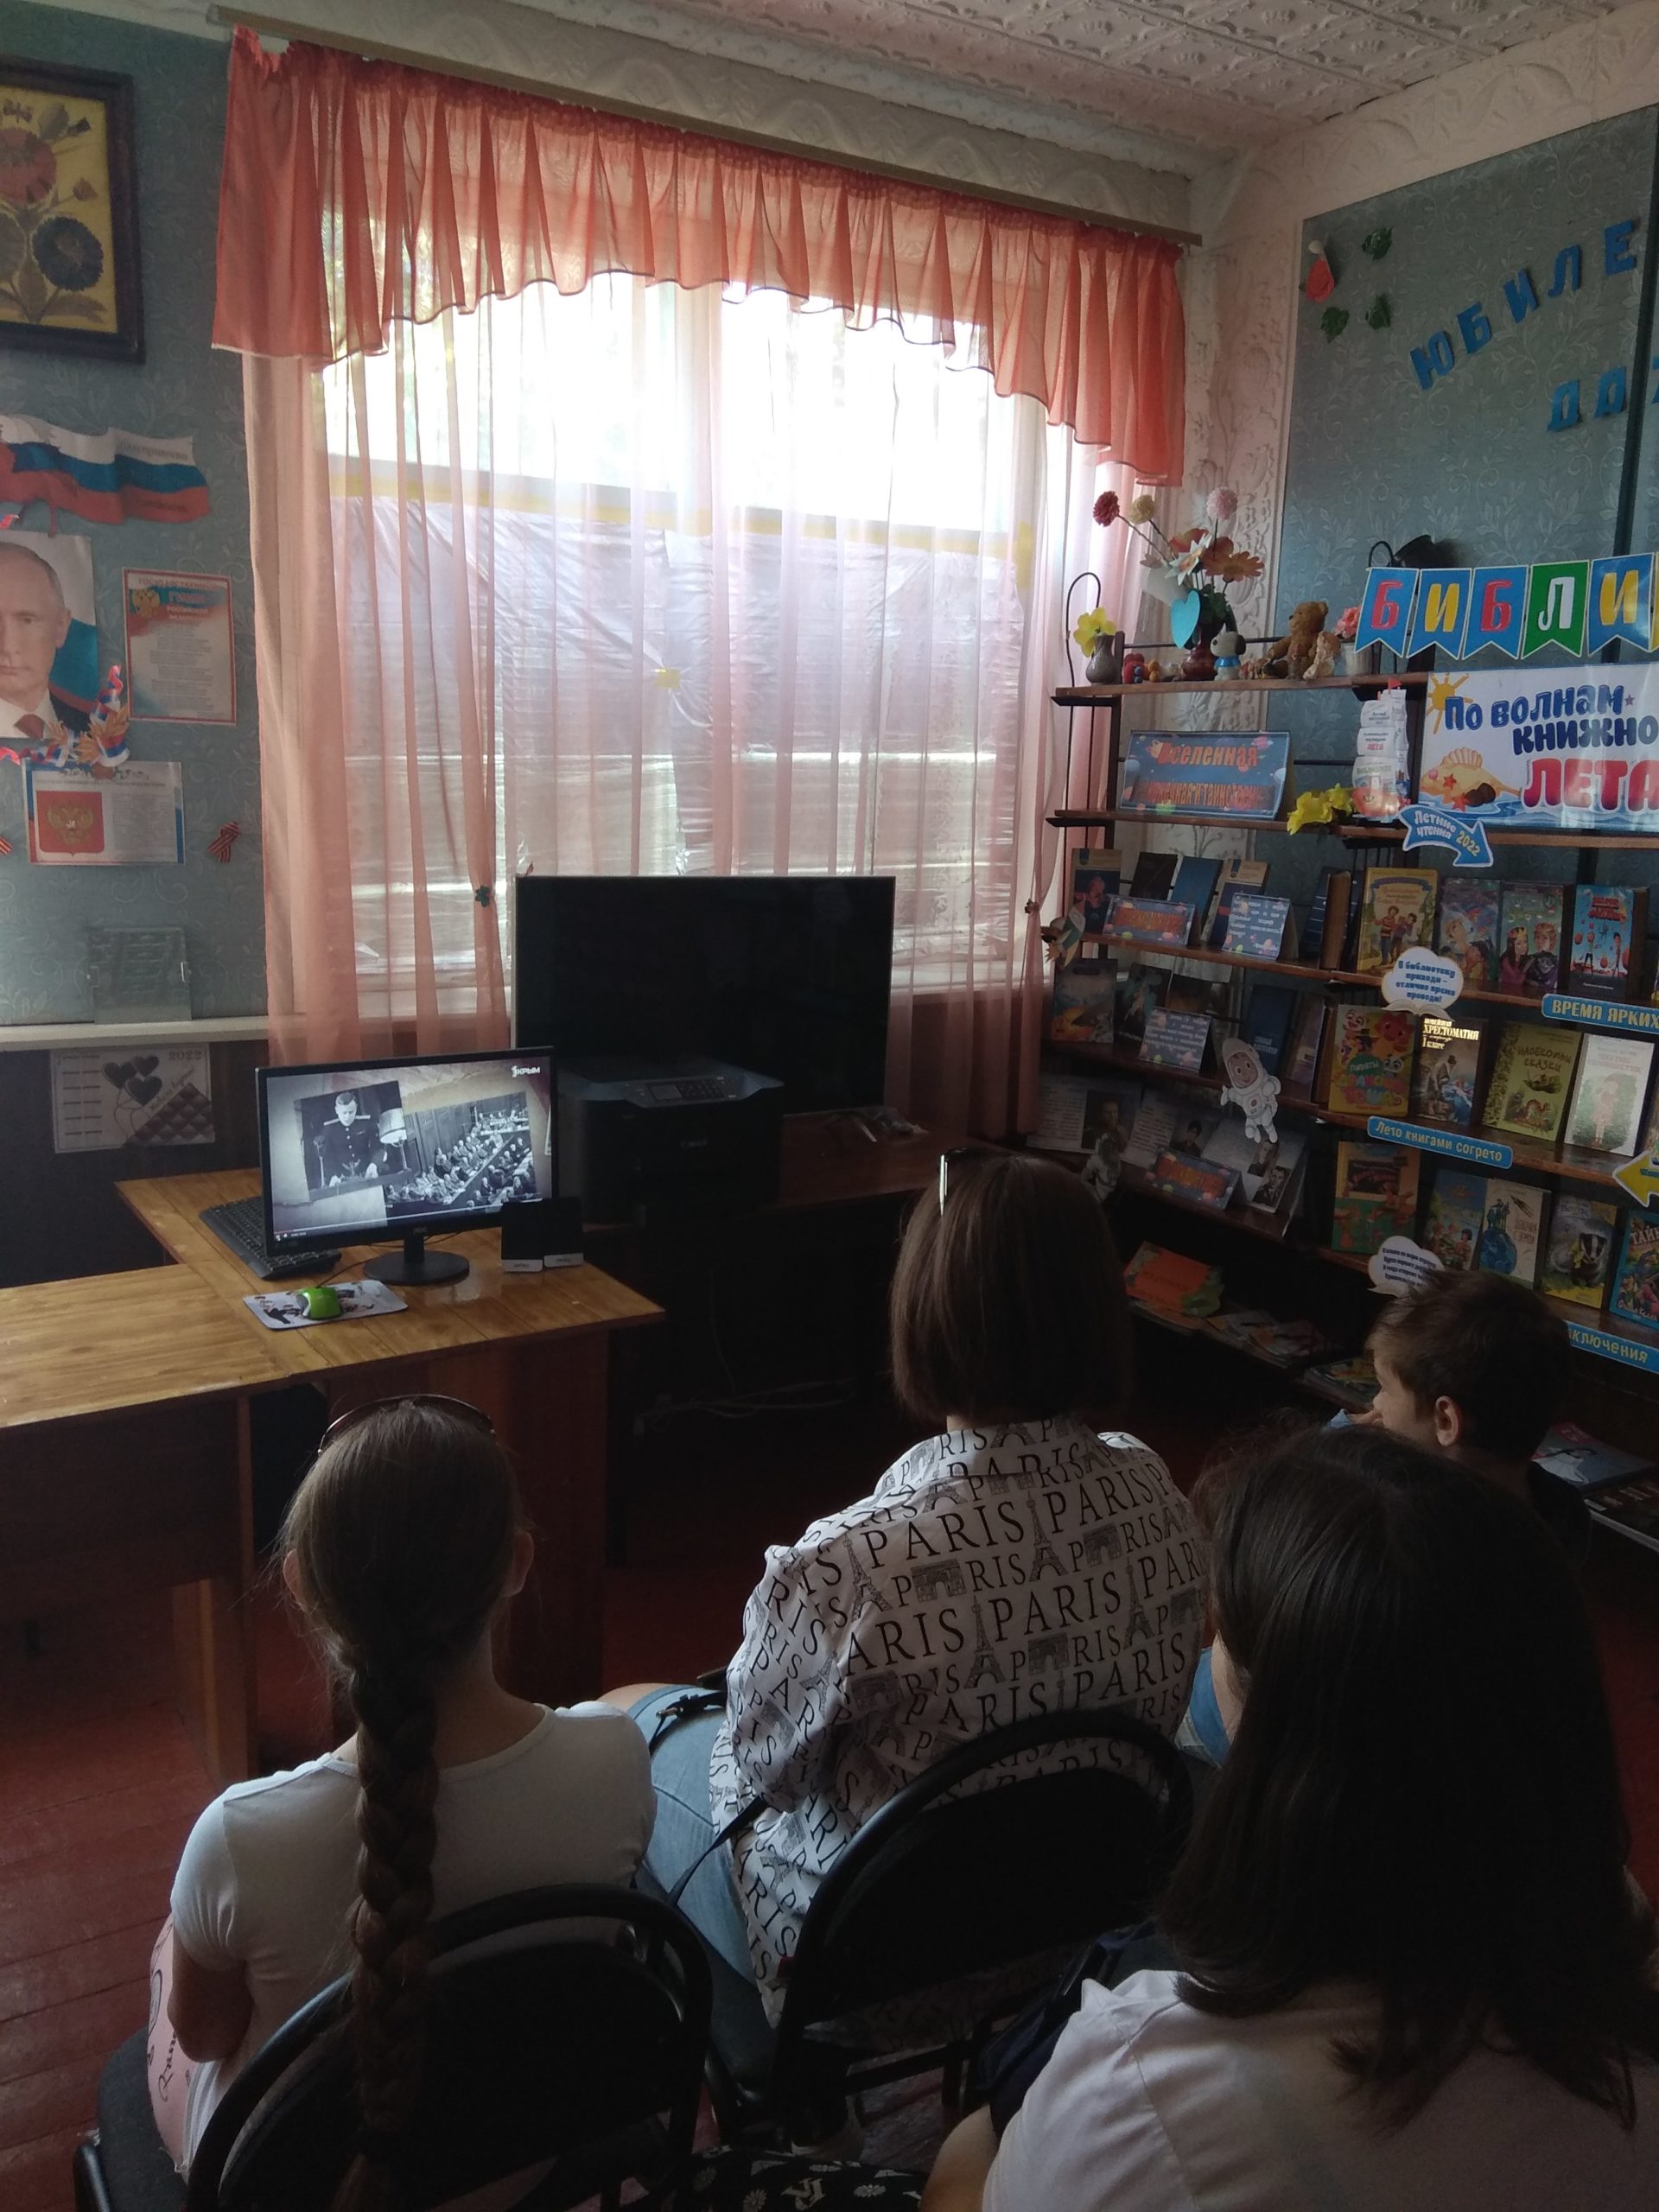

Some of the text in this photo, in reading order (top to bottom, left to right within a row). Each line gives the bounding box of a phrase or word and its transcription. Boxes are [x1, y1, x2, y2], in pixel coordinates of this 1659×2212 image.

[1410, 219, 1637, 391] ЮБИЛЕ
[1370, 569, 1639, 632] БИБЛИ
[1445, 696, 1484, 731] По
[1522, 757, 1659, 810] ЛЕТА
[1414, 810, 1457, 832] Летние
[1455, 830, 1482, 857] 2022
[1552, 1000, 1659, 1028] ВРЕМЯ ЯРКИХ
[168, 1050, 202, 1061] 2022
[1375, 1121, 1503, 1162] Лето книгами согрето
[860, 1501, 1025, 1570] PARIS
[1042, 1468, 1154, 1534] PARIS
[846, 1608, 964, 1677] ARIS
[988, 1571, 1121, 1643] PARIS
[1073, 1632, 1185, 1710] PARIS
